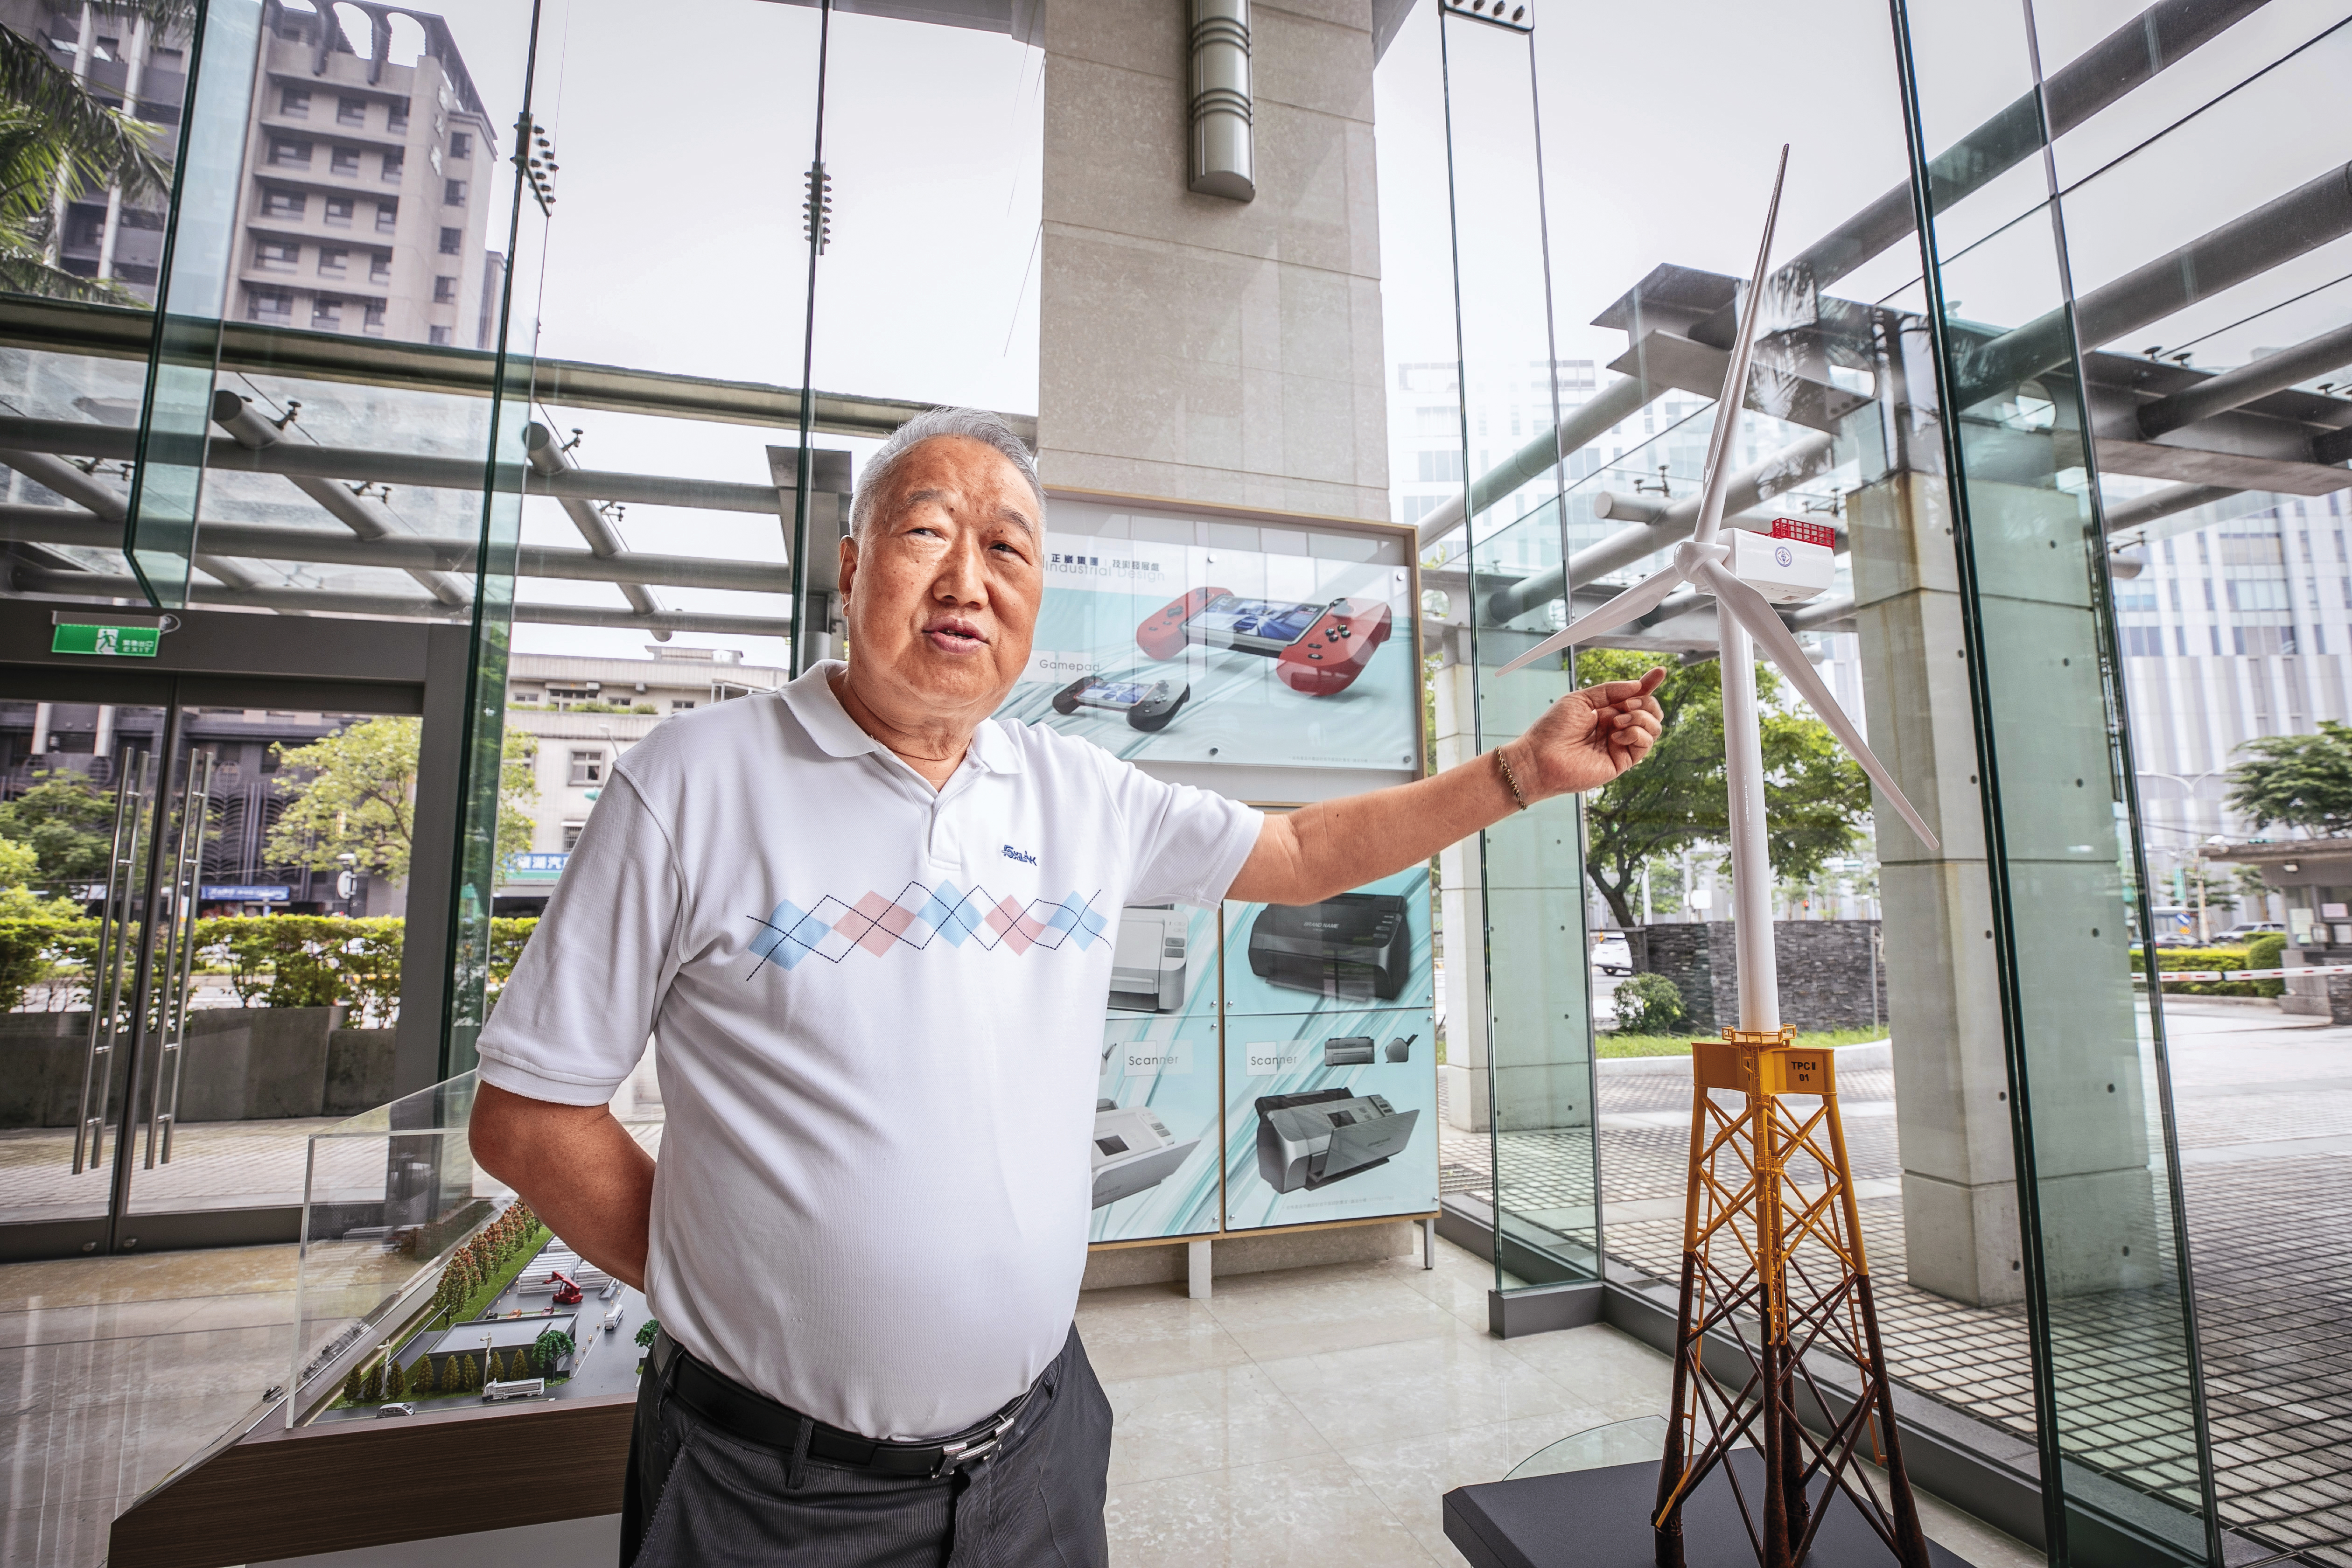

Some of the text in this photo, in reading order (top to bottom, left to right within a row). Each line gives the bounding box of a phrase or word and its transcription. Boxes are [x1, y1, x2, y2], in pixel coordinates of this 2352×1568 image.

[1045, 561, 1165, 583] Industrial Design
[1039, 659, 1100, 672] Gamepad
[1129, 1056, 1178, 1065] Scanner
[1251, 1056, 1296, 1065] Scanner
[1791, 1061, 1810, 1070] TPC
[1799, 1073, 1809, 1082] 01
